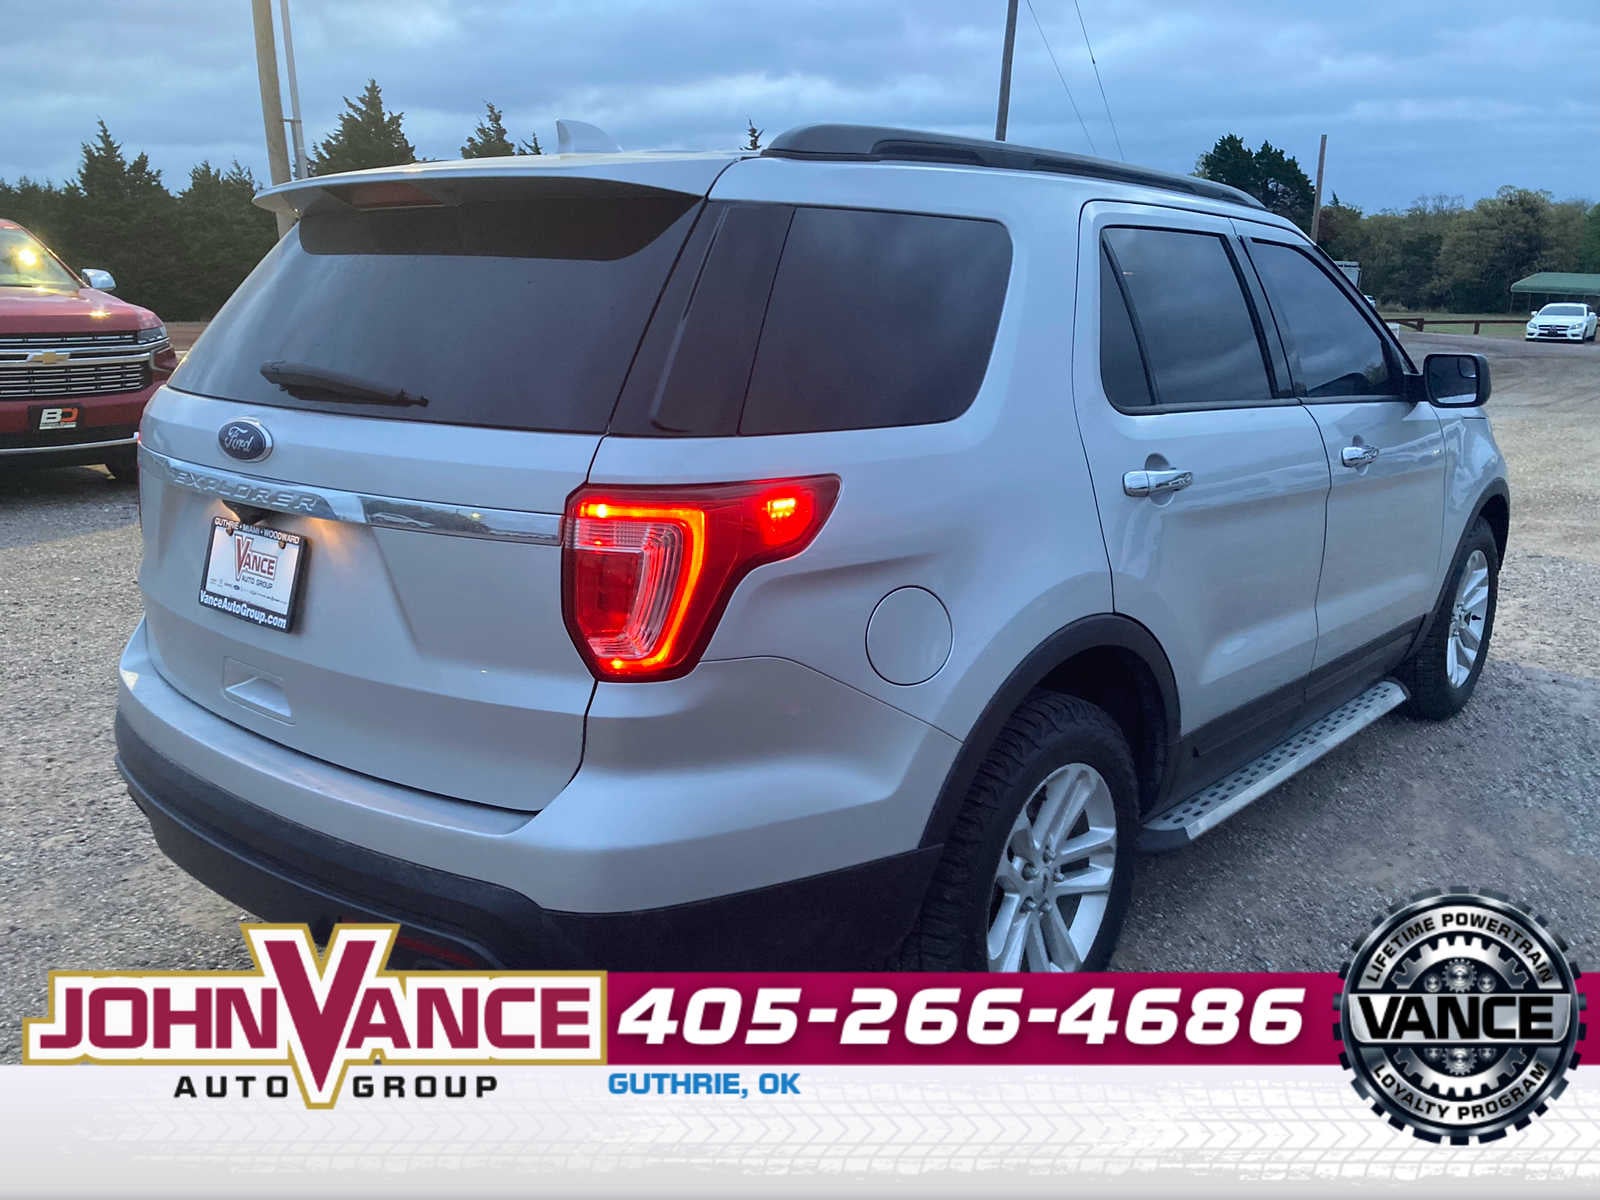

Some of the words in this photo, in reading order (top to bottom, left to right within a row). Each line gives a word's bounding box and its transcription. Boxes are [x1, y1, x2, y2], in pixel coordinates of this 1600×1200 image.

[224, 426, 254, 451] Ford
[174, 471, 316, 511] EXPLORER
[214, 517, 240, 530] GUTHRIE
[263, 528, 300, 544] WOODWARD
[235, 537, 276, 578] VANCE
[241, 575, 256, 585] AUTO
[256, 579, 273, 590] GROUP
[200, 590, 287, 629] VanceAutoGroup.com
